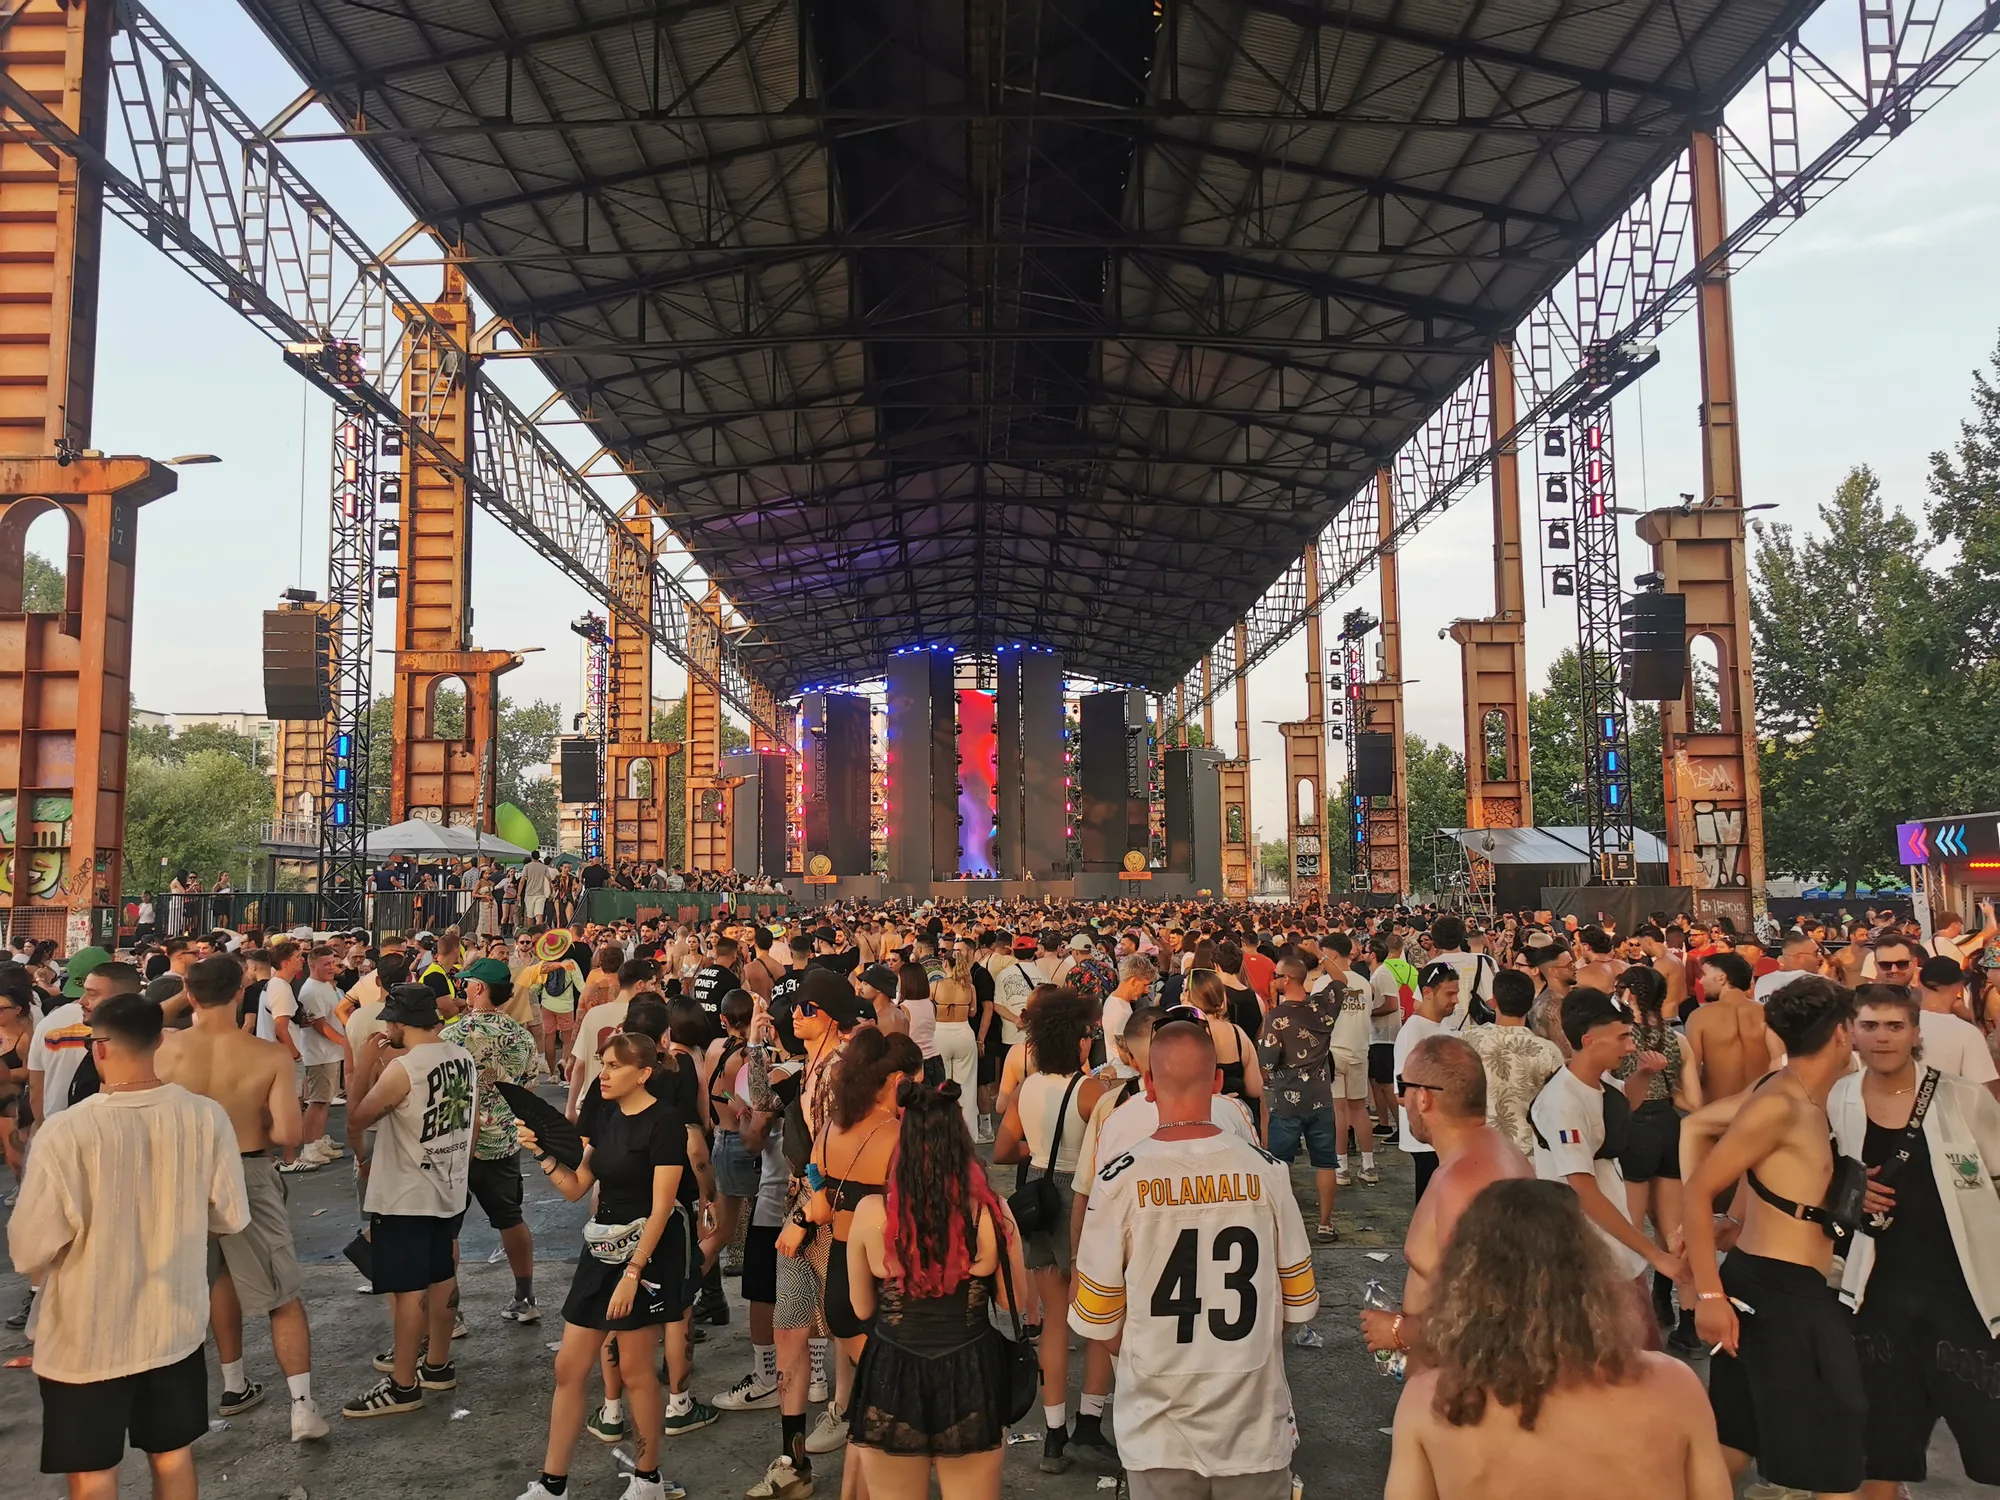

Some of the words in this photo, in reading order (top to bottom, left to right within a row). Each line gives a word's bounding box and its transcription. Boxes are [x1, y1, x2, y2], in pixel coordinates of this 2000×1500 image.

[115, 506, 121, 521] C
[112, 526, 123, 545] 17
[696, 990, 709, 999] NOT
[1915, 1081, 1934, 1116] adidas
[1944, 1152, 1979, 1163] MIAM
[1137, 1173, 1261, 1208] POLAMALU
[1150, 1225, 1260, 1344] 43
